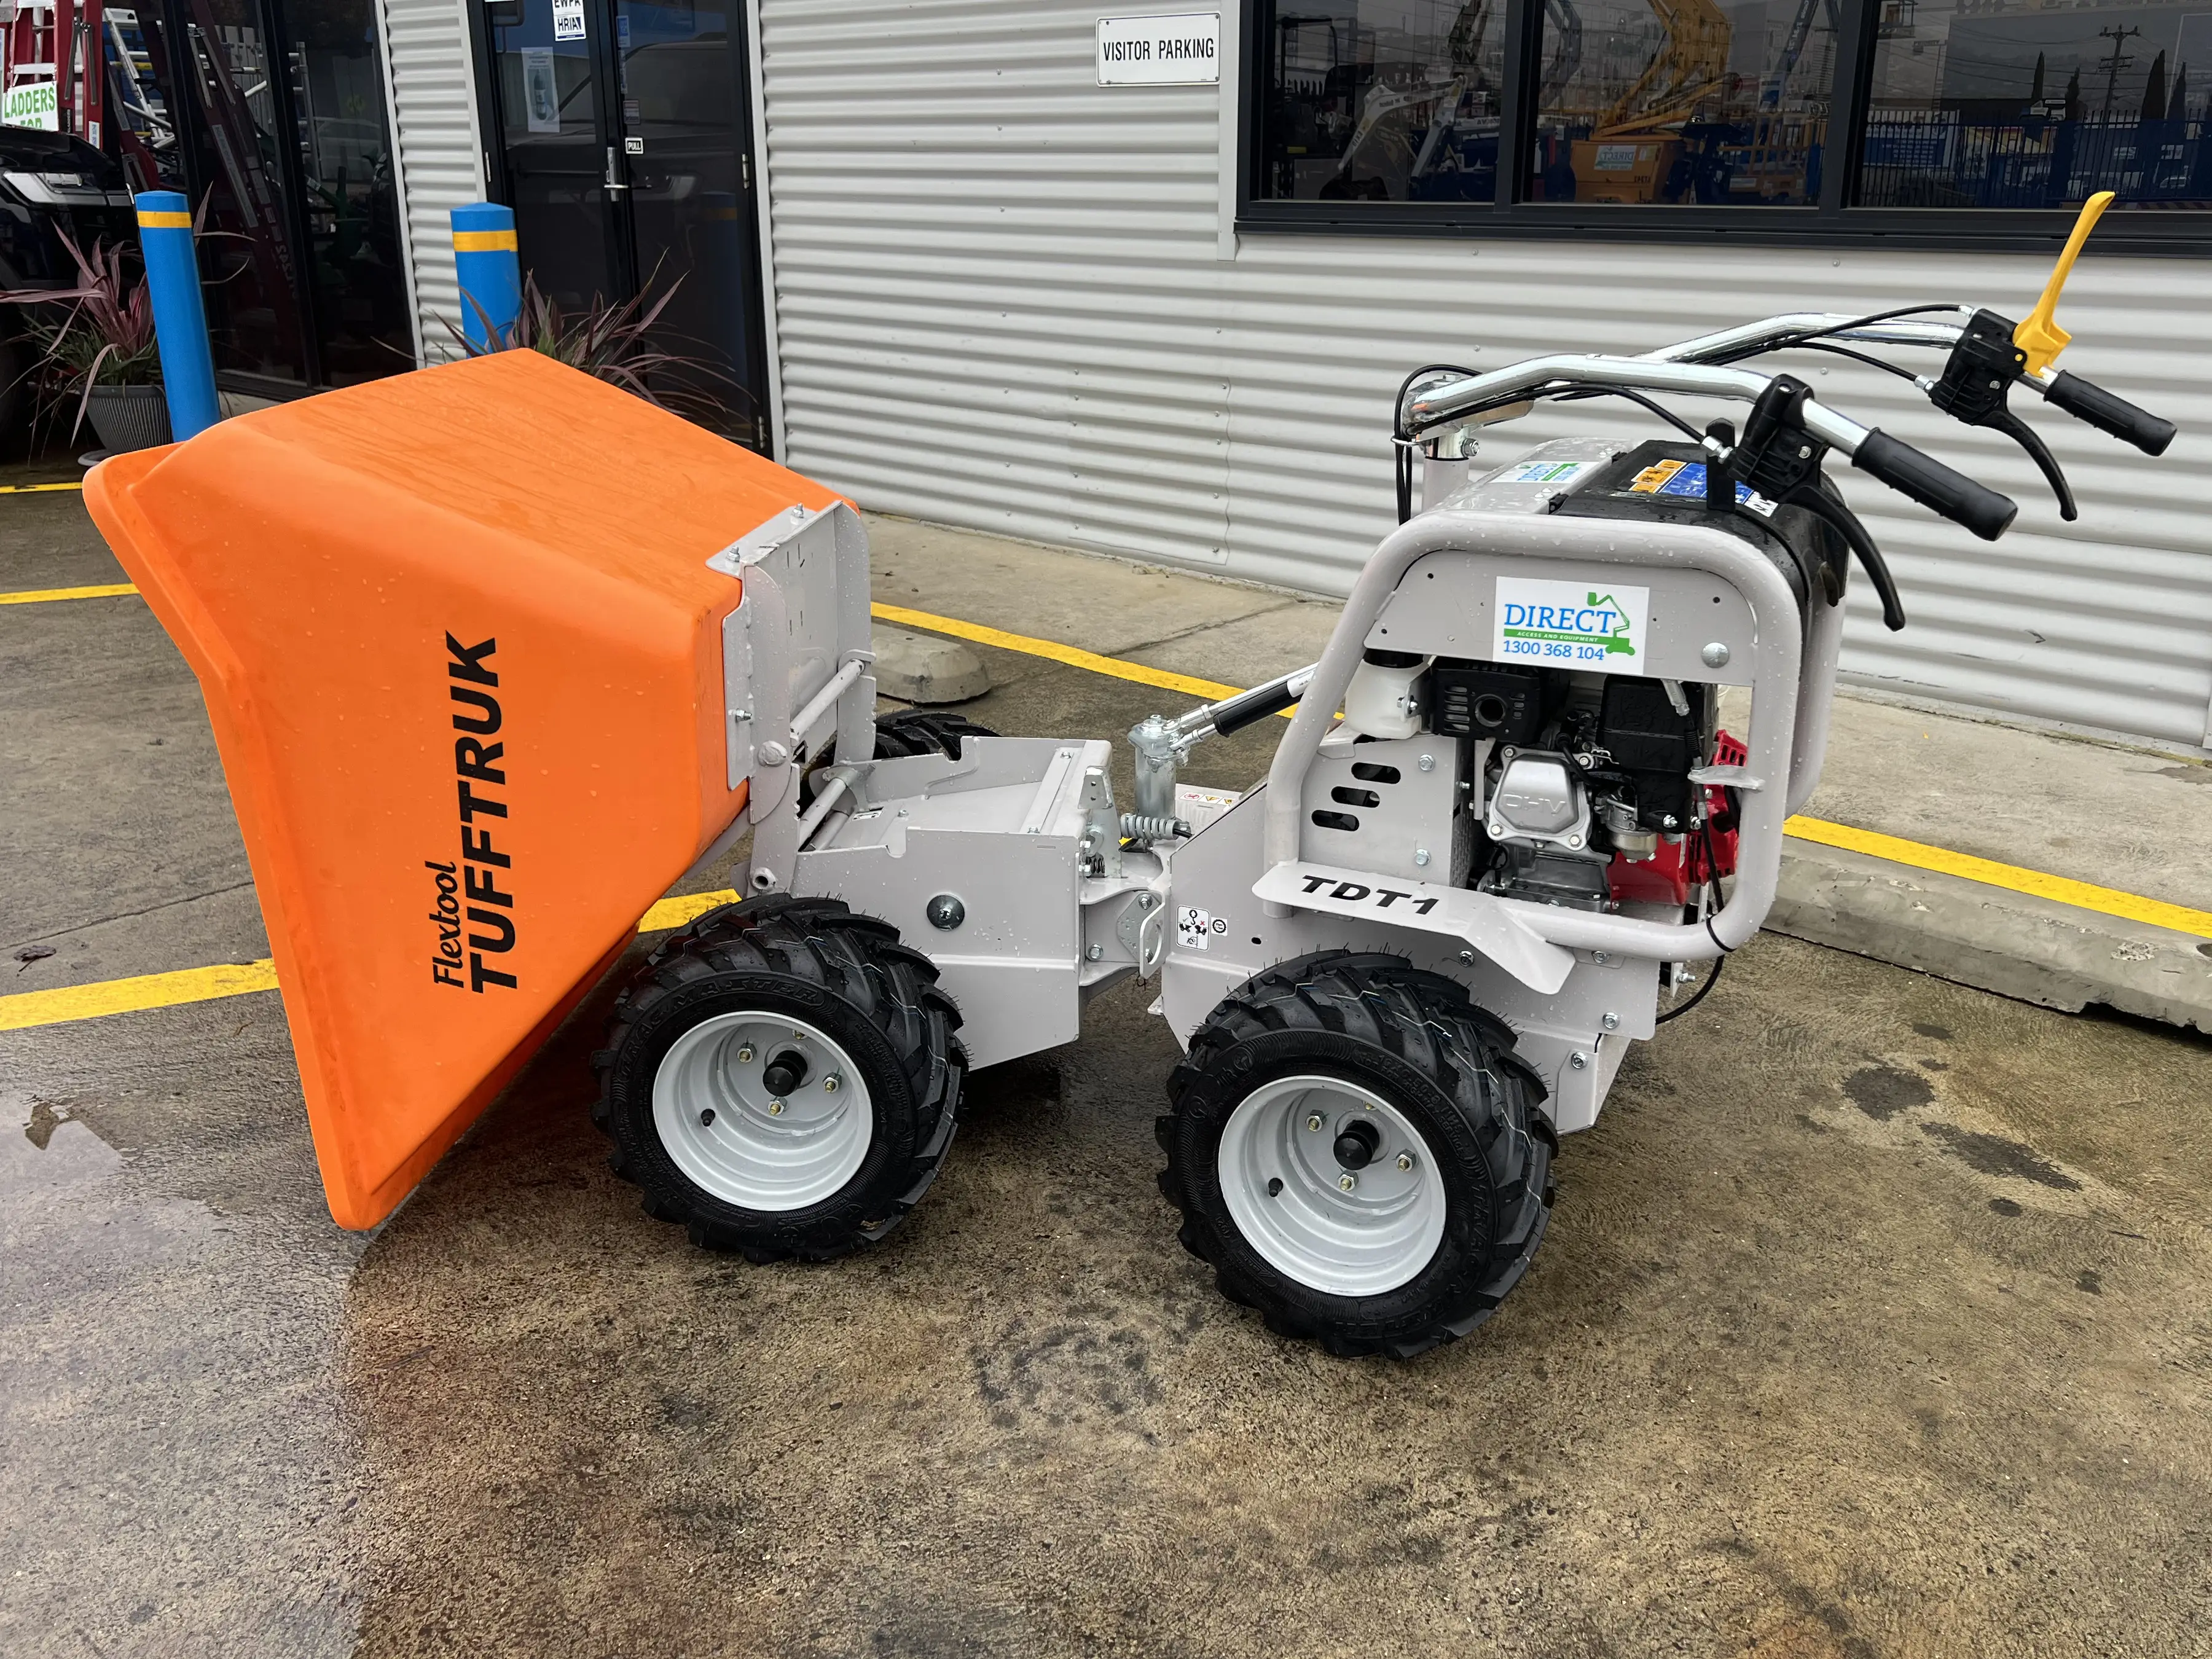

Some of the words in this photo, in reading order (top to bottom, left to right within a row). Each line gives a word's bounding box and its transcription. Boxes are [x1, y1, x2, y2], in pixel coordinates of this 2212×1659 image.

[557, 17, 581, 31] HRIA
[1104, 41, 1150, 61] VISITOR
[1159, 38, 1214, 59] PARKING
[4, 87, 55, 118] LADDERS
[628, 141, 641, 151] PULL
[1504, 603, 1616, 633] DIRECT
[1504, 640, 1540, 654] 1300
[1543, 643, 1572, 657] 368
[1577, 646, 1604, 661] 104
[445, 630, 518, 994] TUFFTRUK
[1301, 875, 1439, 915] TDT1
[424, 860, 465, 989] Flextool
[1437, 1115, 1466, 1154] SERVICE
